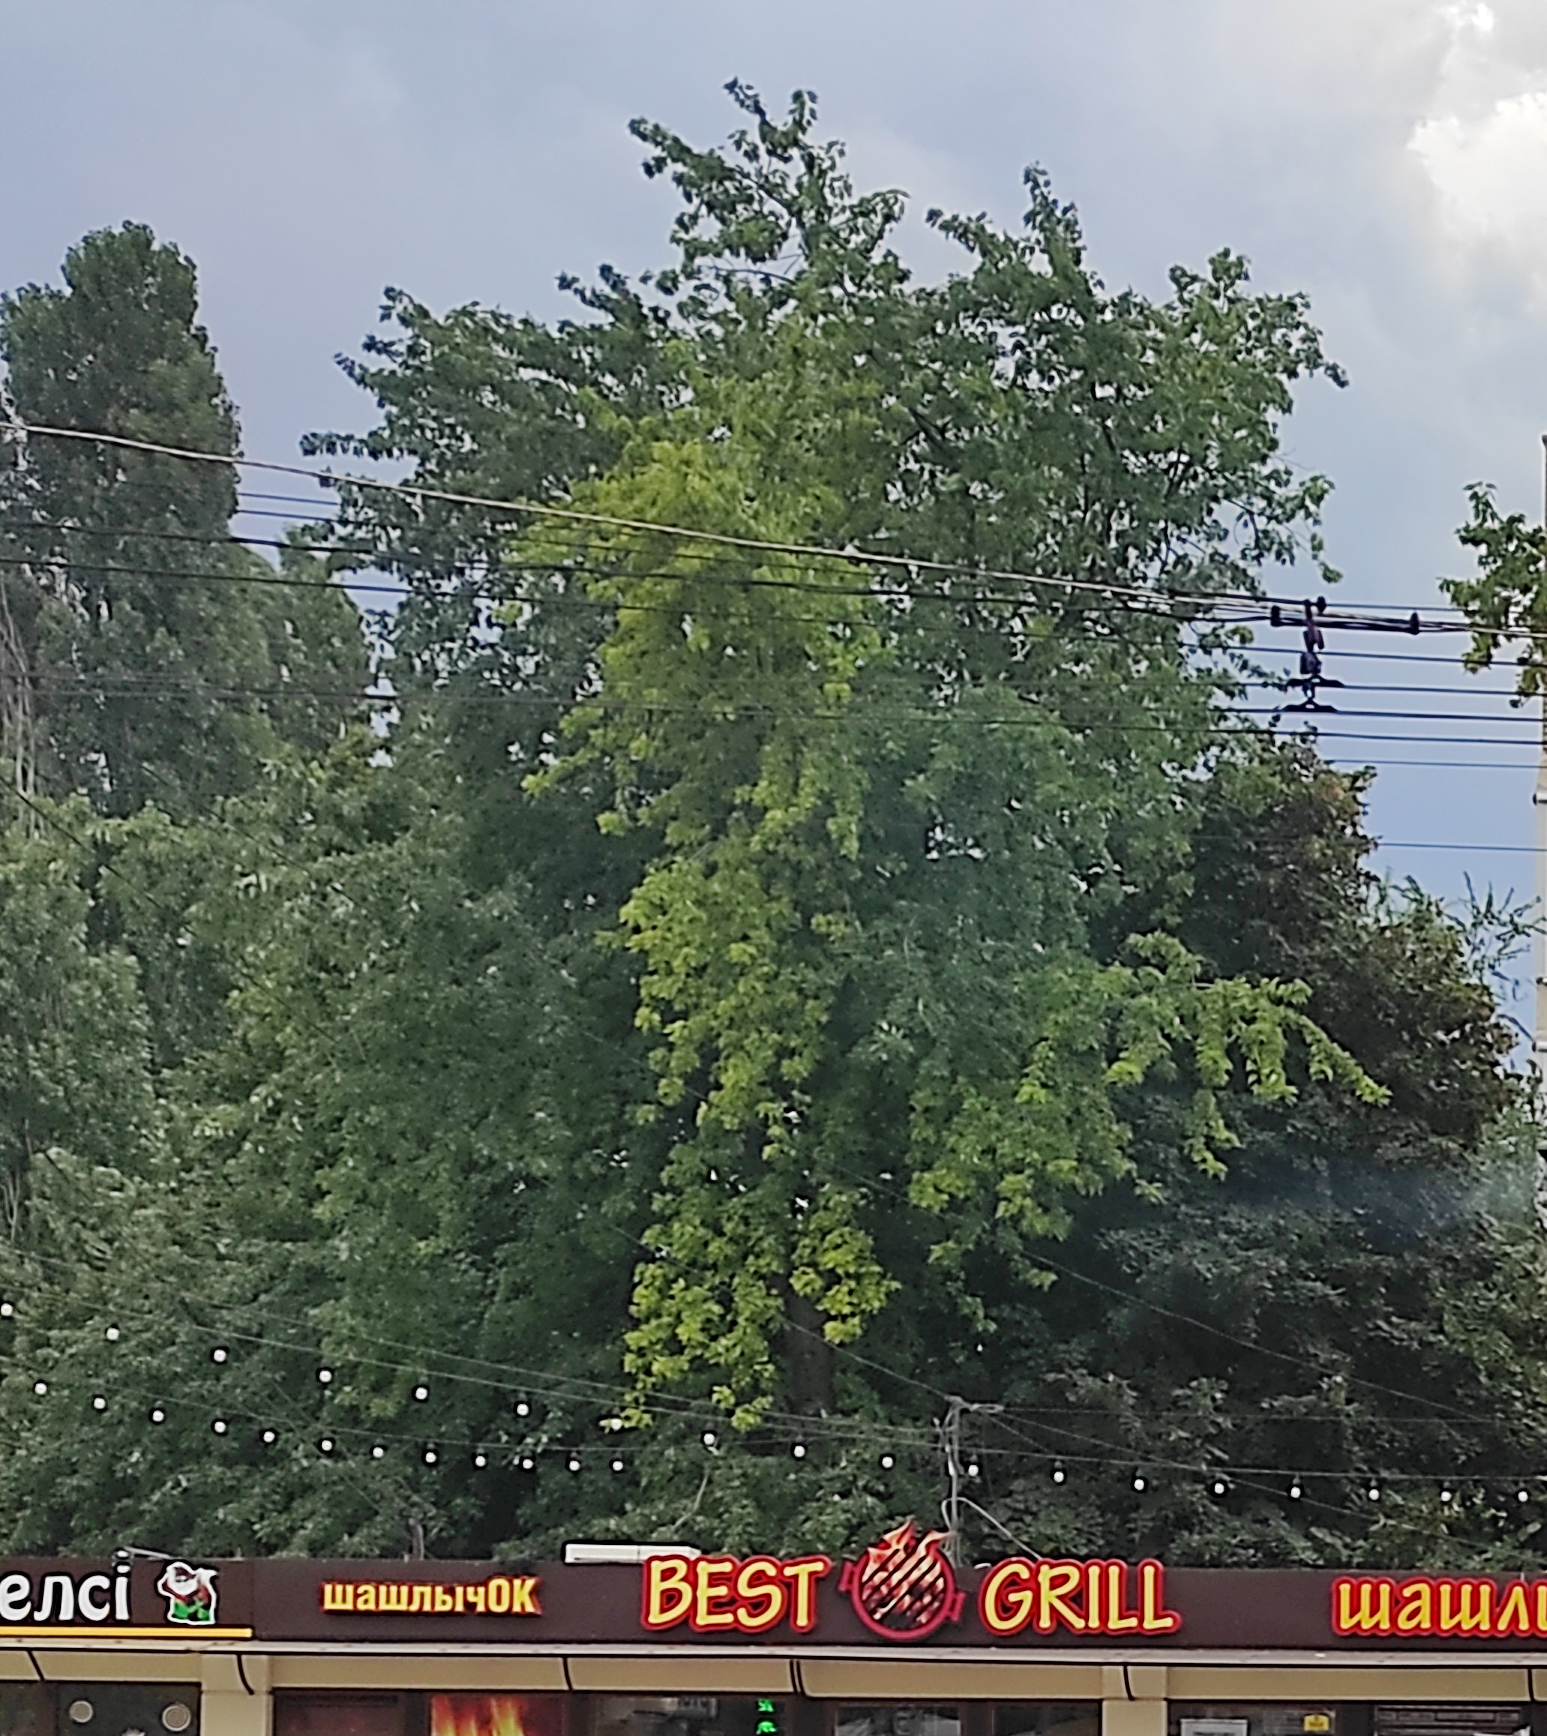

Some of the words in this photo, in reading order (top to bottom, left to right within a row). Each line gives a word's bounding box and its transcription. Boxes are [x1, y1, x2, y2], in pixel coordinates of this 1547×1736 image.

[321, 1576, 541, 1616] шашлычОК
[645, 1557, 827, 1630] BEST
[982, 1559, 1178, 1632] GRILL
